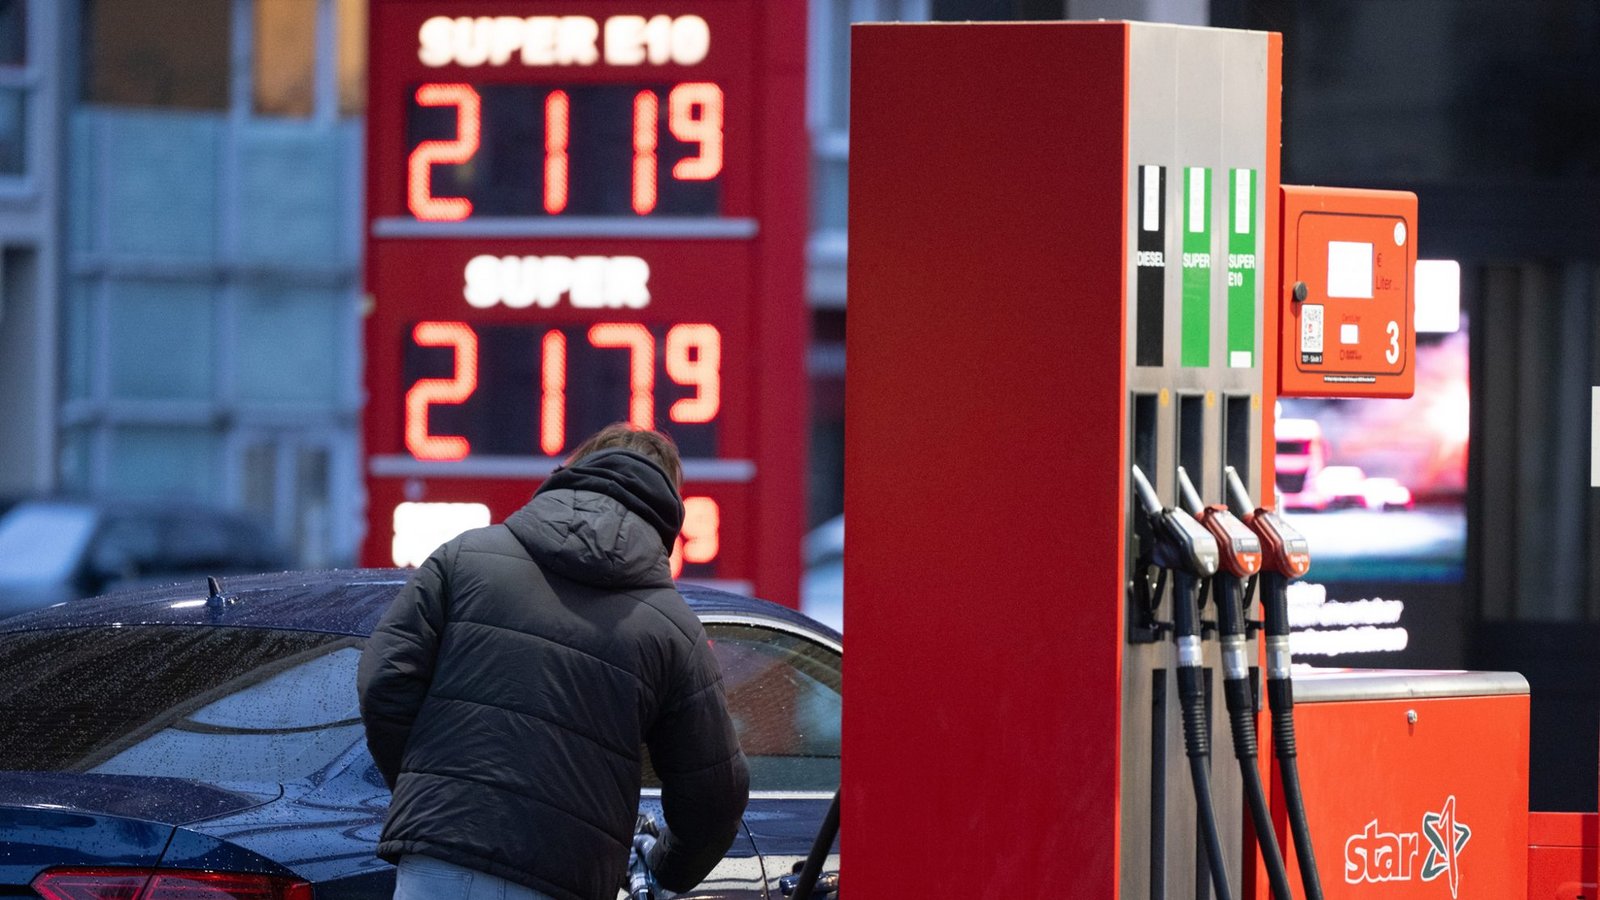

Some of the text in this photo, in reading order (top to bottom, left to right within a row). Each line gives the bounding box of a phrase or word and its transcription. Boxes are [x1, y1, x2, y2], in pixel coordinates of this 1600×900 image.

[418, 15, 710, 67] SUPER E10
[1137, 251, 1165, 267] DIESEL
[1183, 252, 1210, 268] SUPER
[1228, 254, 1255, 268] SUPER
[464, 256, 650, 309] SUPER
[1228, 271, 1243, 287] E10
[1375, 275, 1392, 290] Liter
[1385, 320, 1400, 364] 3
[1345, 818, 1419, 884] star
